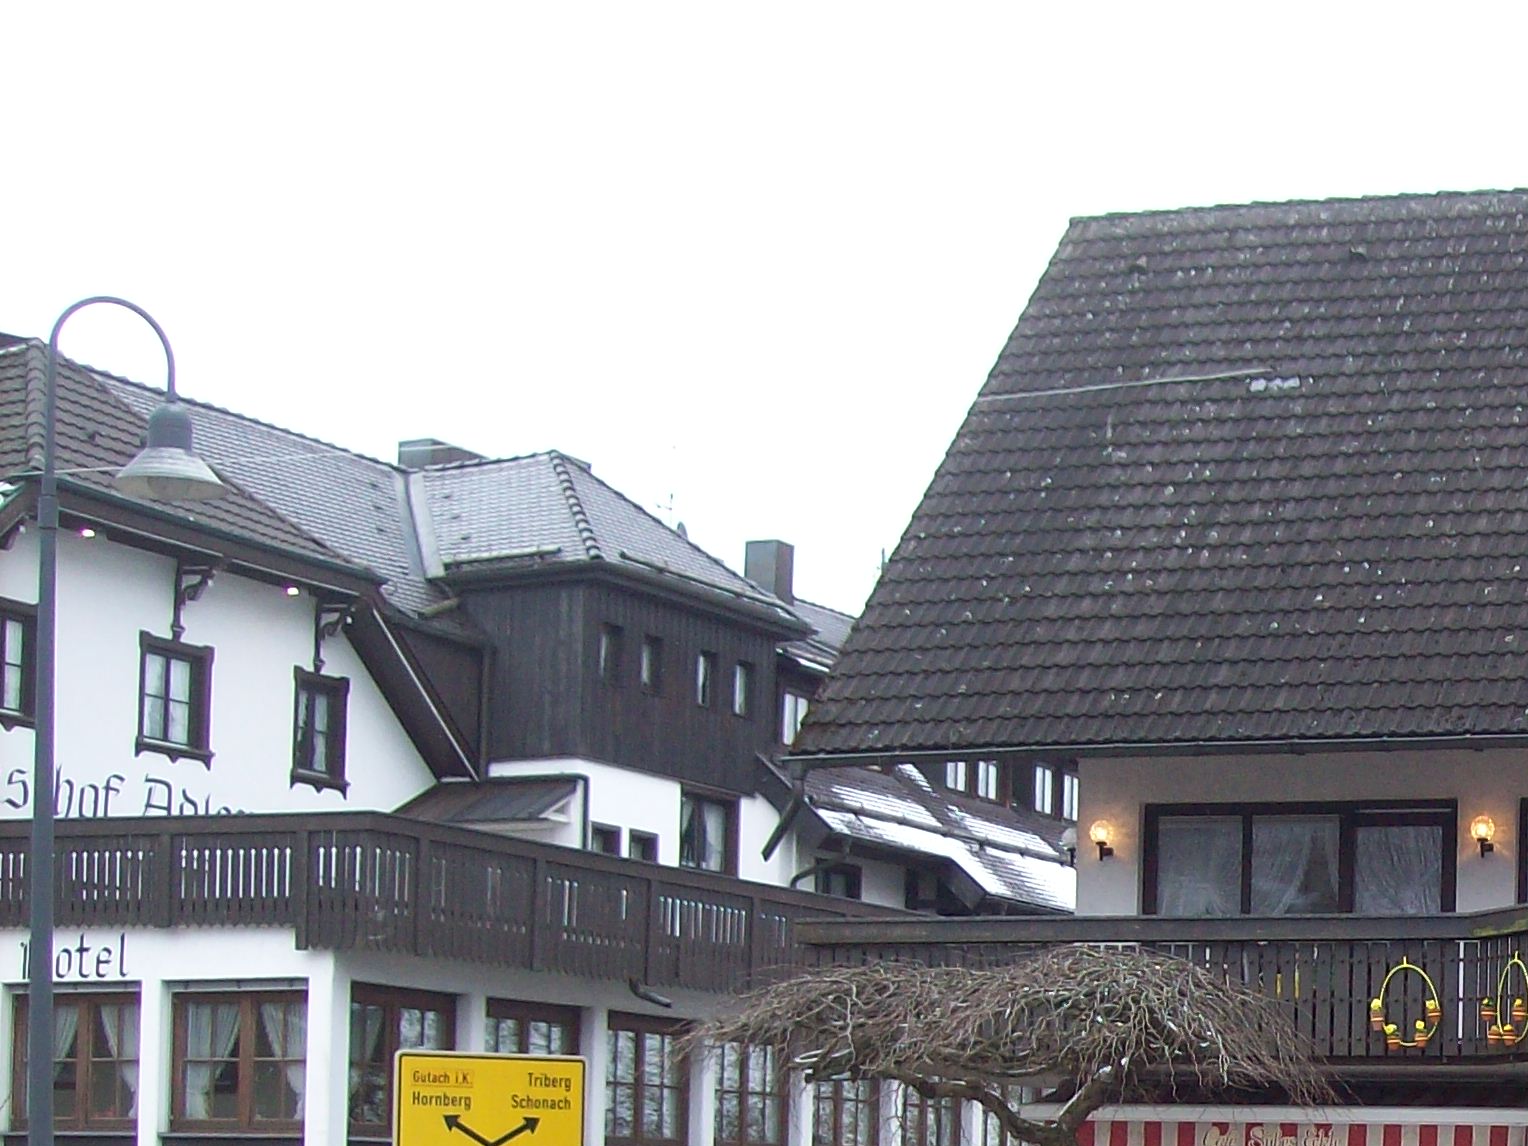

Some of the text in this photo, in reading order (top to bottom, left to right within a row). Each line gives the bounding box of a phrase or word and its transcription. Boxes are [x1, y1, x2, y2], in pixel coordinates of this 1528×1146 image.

[3, 764, 126, 817] shof
[412, 1071, 450, 1084] Gutach
[527, 1072, 572, 1092] Triberg
[412, 1091, 472, 1110] Hornberg
[511, 1094, 571, 1110] Schonach
